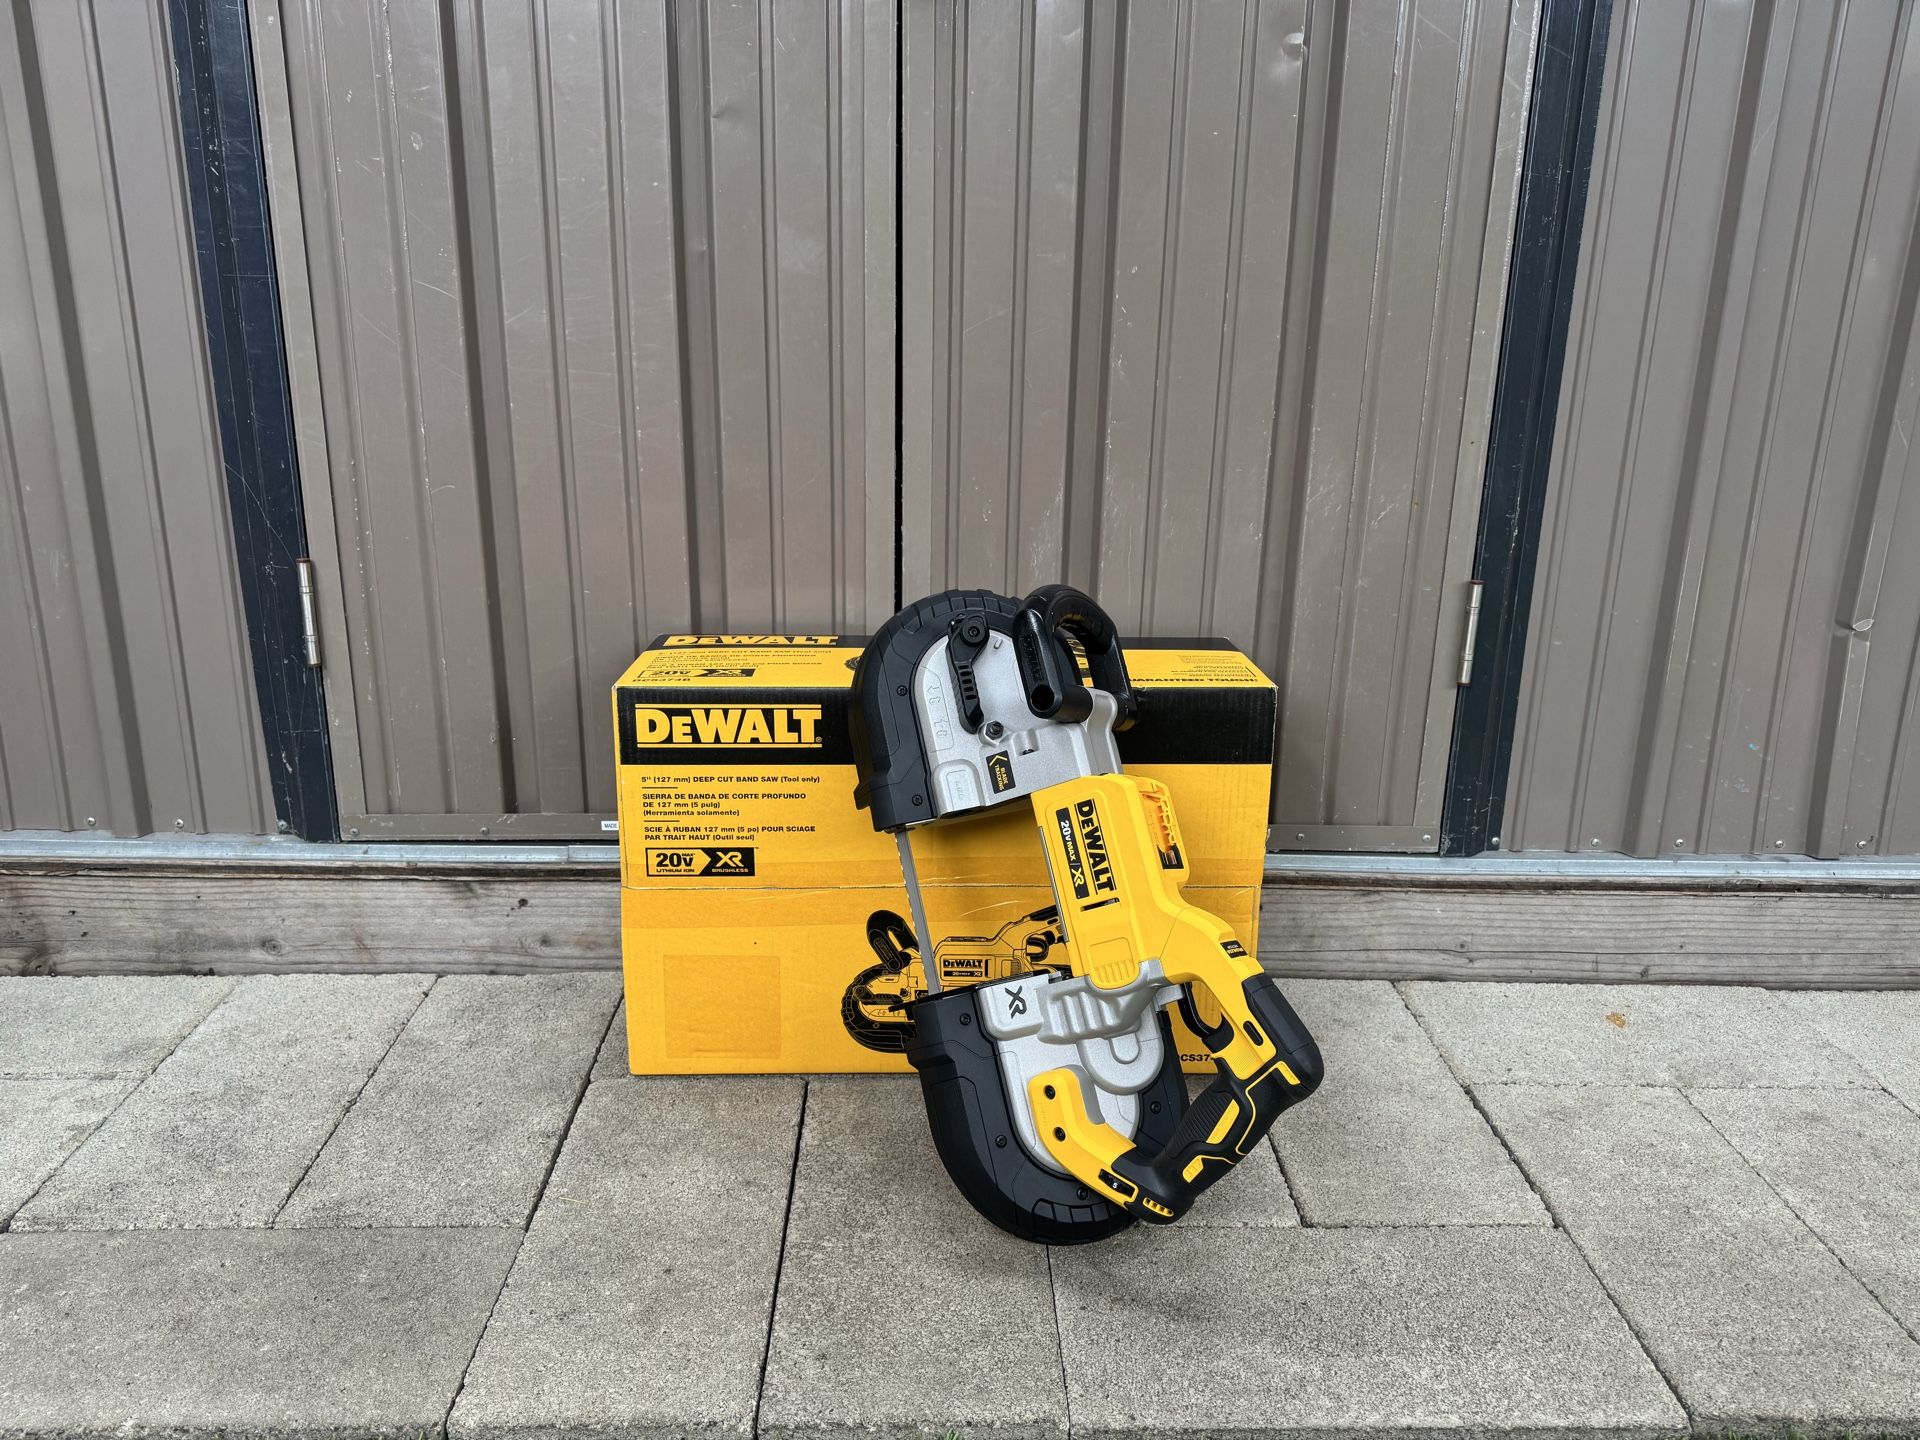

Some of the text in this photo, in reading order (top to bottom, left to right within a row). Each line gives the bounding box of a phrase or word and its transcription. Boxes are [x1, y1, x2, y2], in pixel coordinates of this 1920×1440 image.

[662, 635, 839, 647] DEWALT
[635, 708, 822, 743] DEWALT
[700, 801, 720, 809] pulg)
[643, 809, 694, 817] (Herramienta
[665, 825, 671, 833] À
[1076, 799, 1115, 891] DEWALT
[715, 851, 745, 867] XR
[1066, 841, 1076, 861] MAX
[1071, 867, 1085, 888] XR
[943, 959, 982, 968] DEWALT
[1005, 985, 1027, 1019] XR
[1180, 1053, 1211, 1062] CS37
